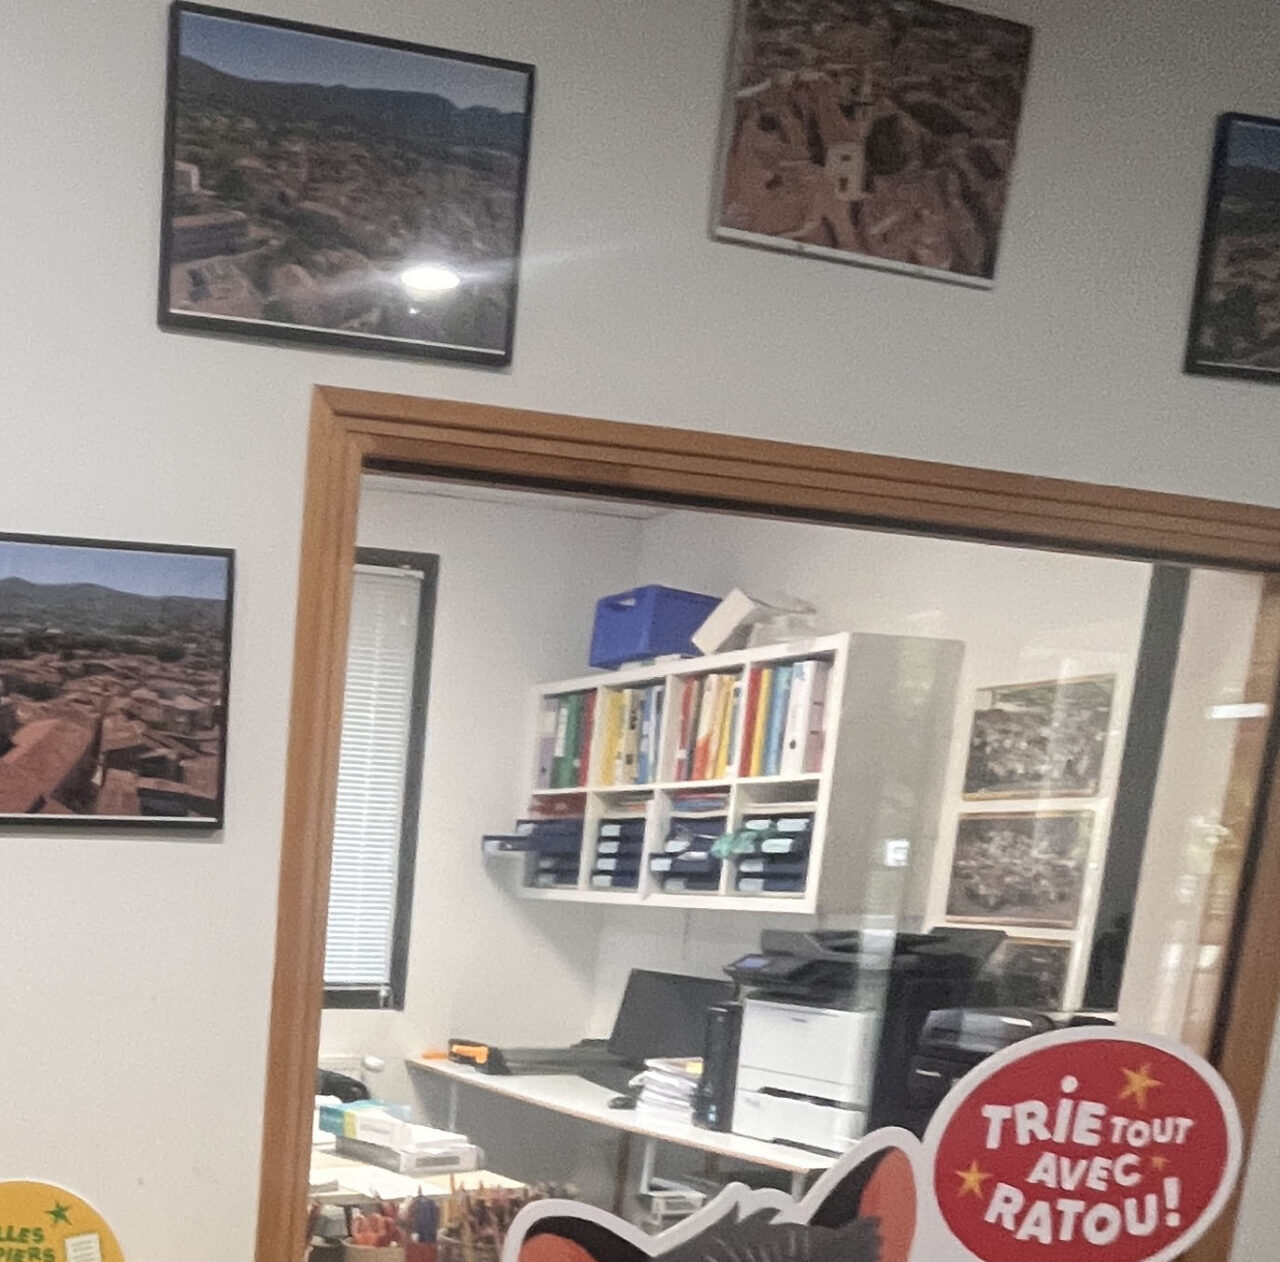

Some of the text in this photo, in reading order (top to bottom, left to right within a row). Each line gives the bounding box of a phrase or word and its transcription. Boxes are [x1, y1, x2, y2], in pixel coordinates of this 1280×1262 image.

[1110, 1116, 1194, 1147] TOUT
[1026, 1152, 1141, 1191] AVEC
[984, 1177, 1181, 1245] RATOU!
